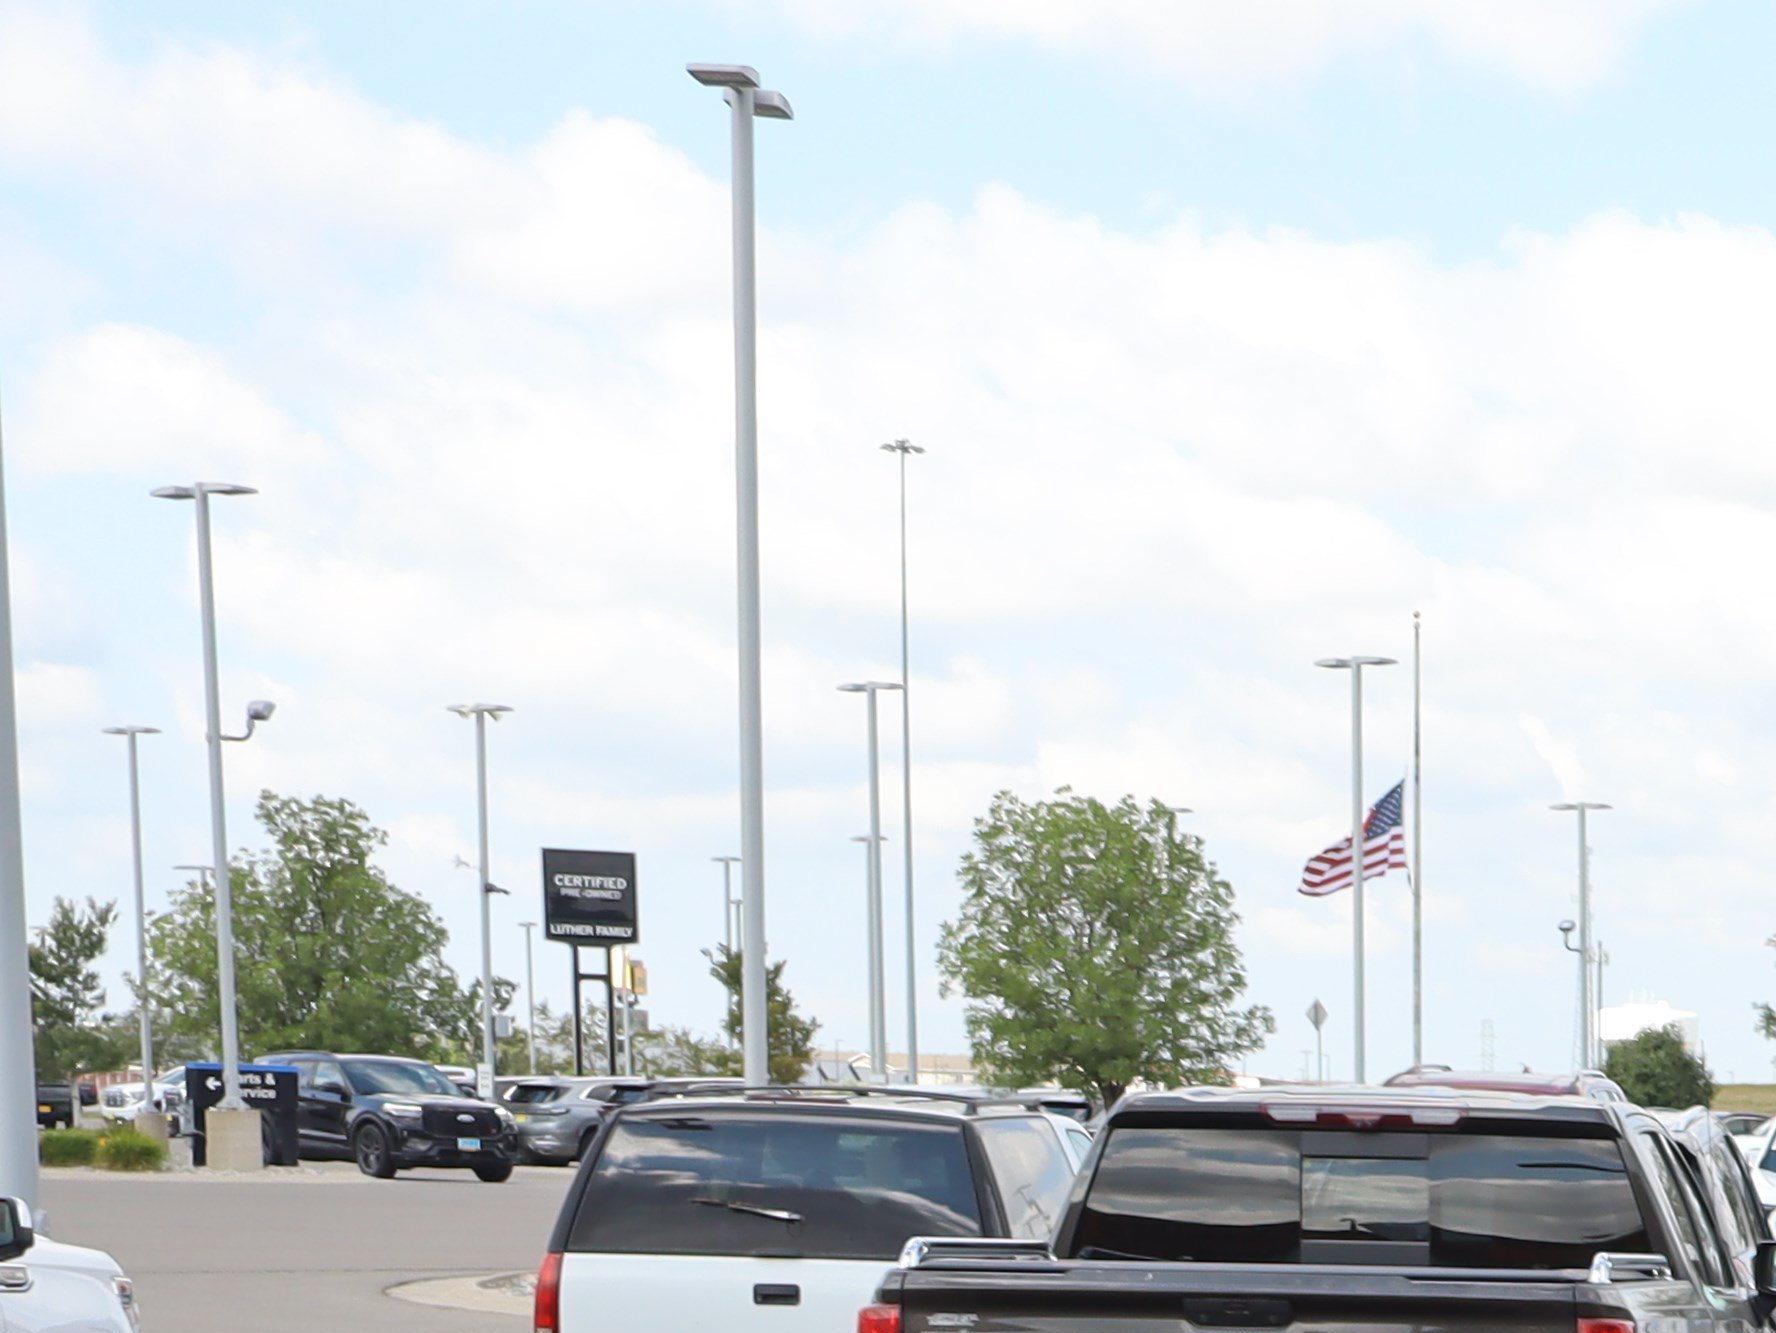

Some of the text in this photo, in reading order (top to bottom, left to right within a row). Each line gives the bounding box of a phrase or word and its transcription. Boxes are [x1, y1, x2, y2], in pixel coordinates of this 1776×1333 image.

[554, 874, 627, 889] CERTIFIED
[549, 923, 634, 938] LUTHER FAMILY
[264, 1072, 276, 1086] &
